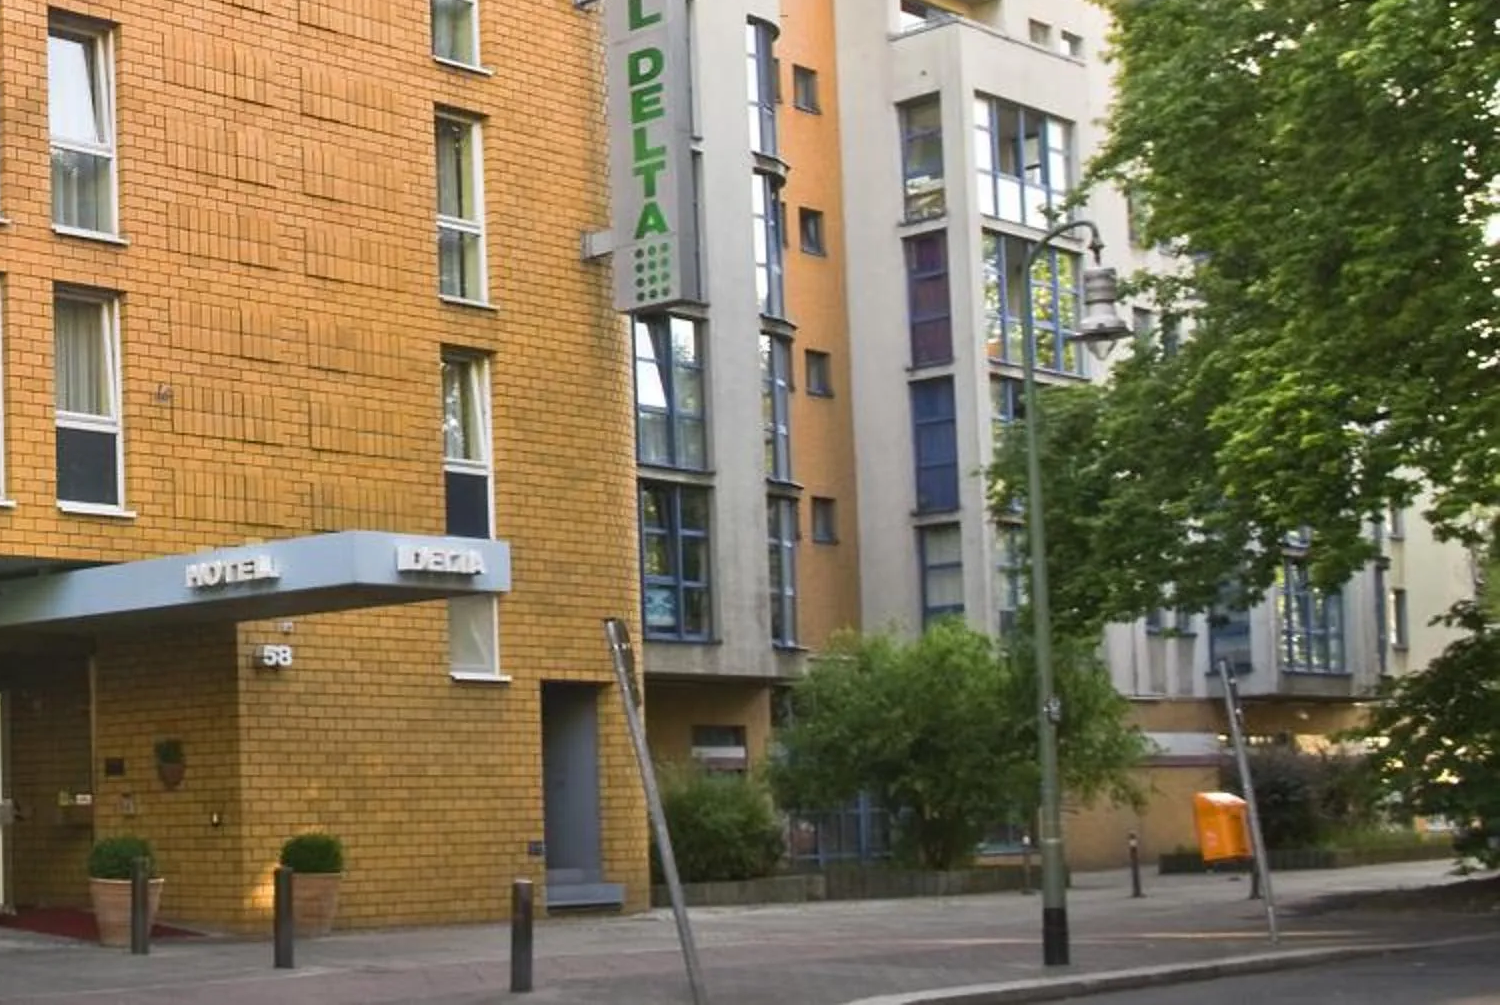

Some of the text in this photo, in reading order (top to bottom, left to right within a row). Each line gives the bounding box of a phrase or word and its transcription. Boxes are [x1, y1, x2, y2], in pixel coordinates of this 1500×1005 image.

[628, 47, 669, 240] DELTA
[186, 555, 280, 588] HOTEL
[263, 645, 293, 666] 58
